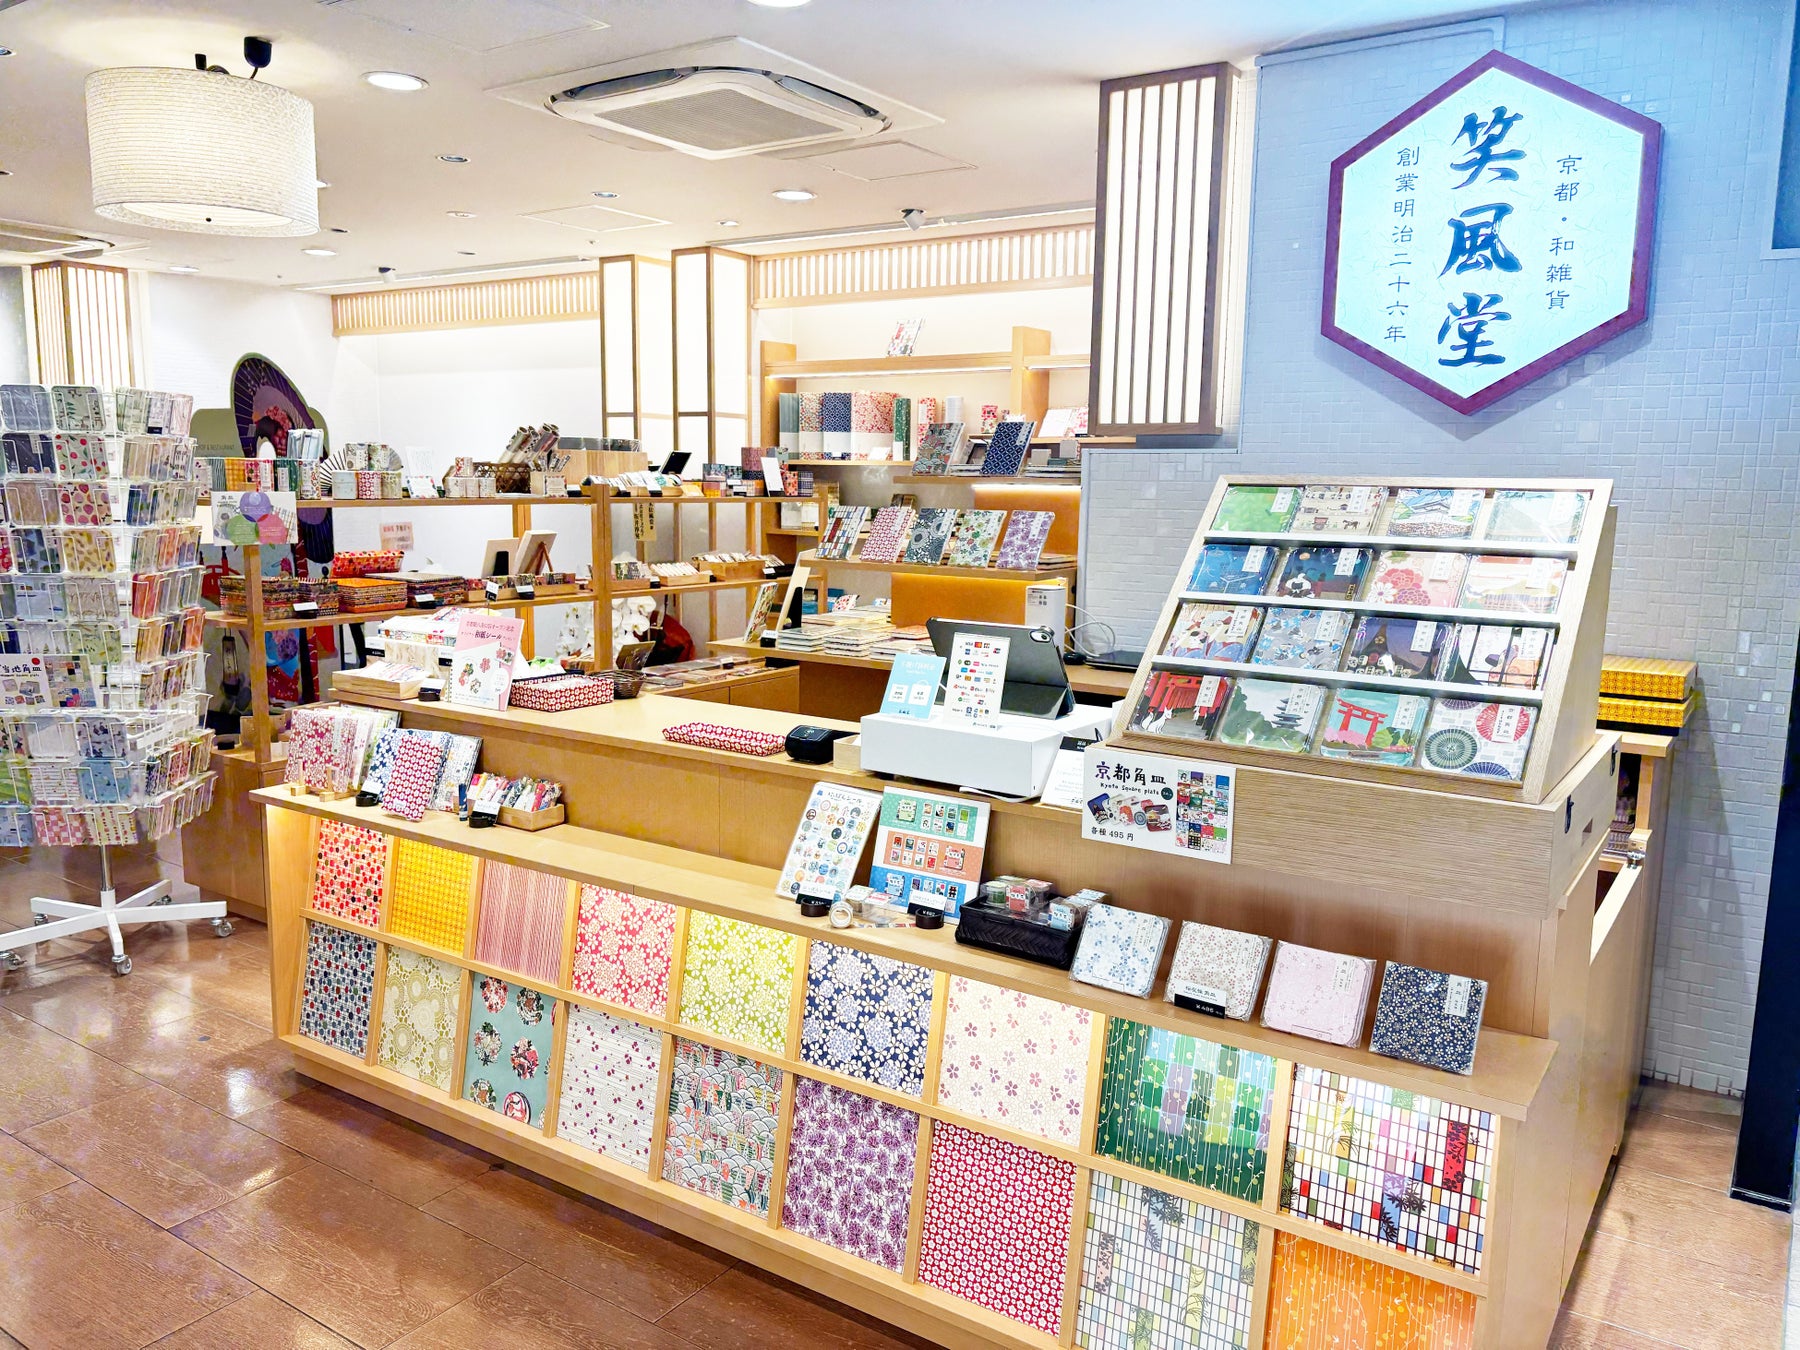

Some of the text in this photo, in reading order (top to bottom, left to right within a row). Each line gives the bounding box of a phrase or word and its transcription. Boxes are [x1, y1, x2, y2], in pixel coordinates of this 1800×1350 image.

[1384, 146, 1420, 343] 創業明治二十六年
[1437, 105, 1527, 367] 笑風堂
[0, 664, 42, 674] 当地角皿
[1095, 761, 1166, 786] 京都角皿
